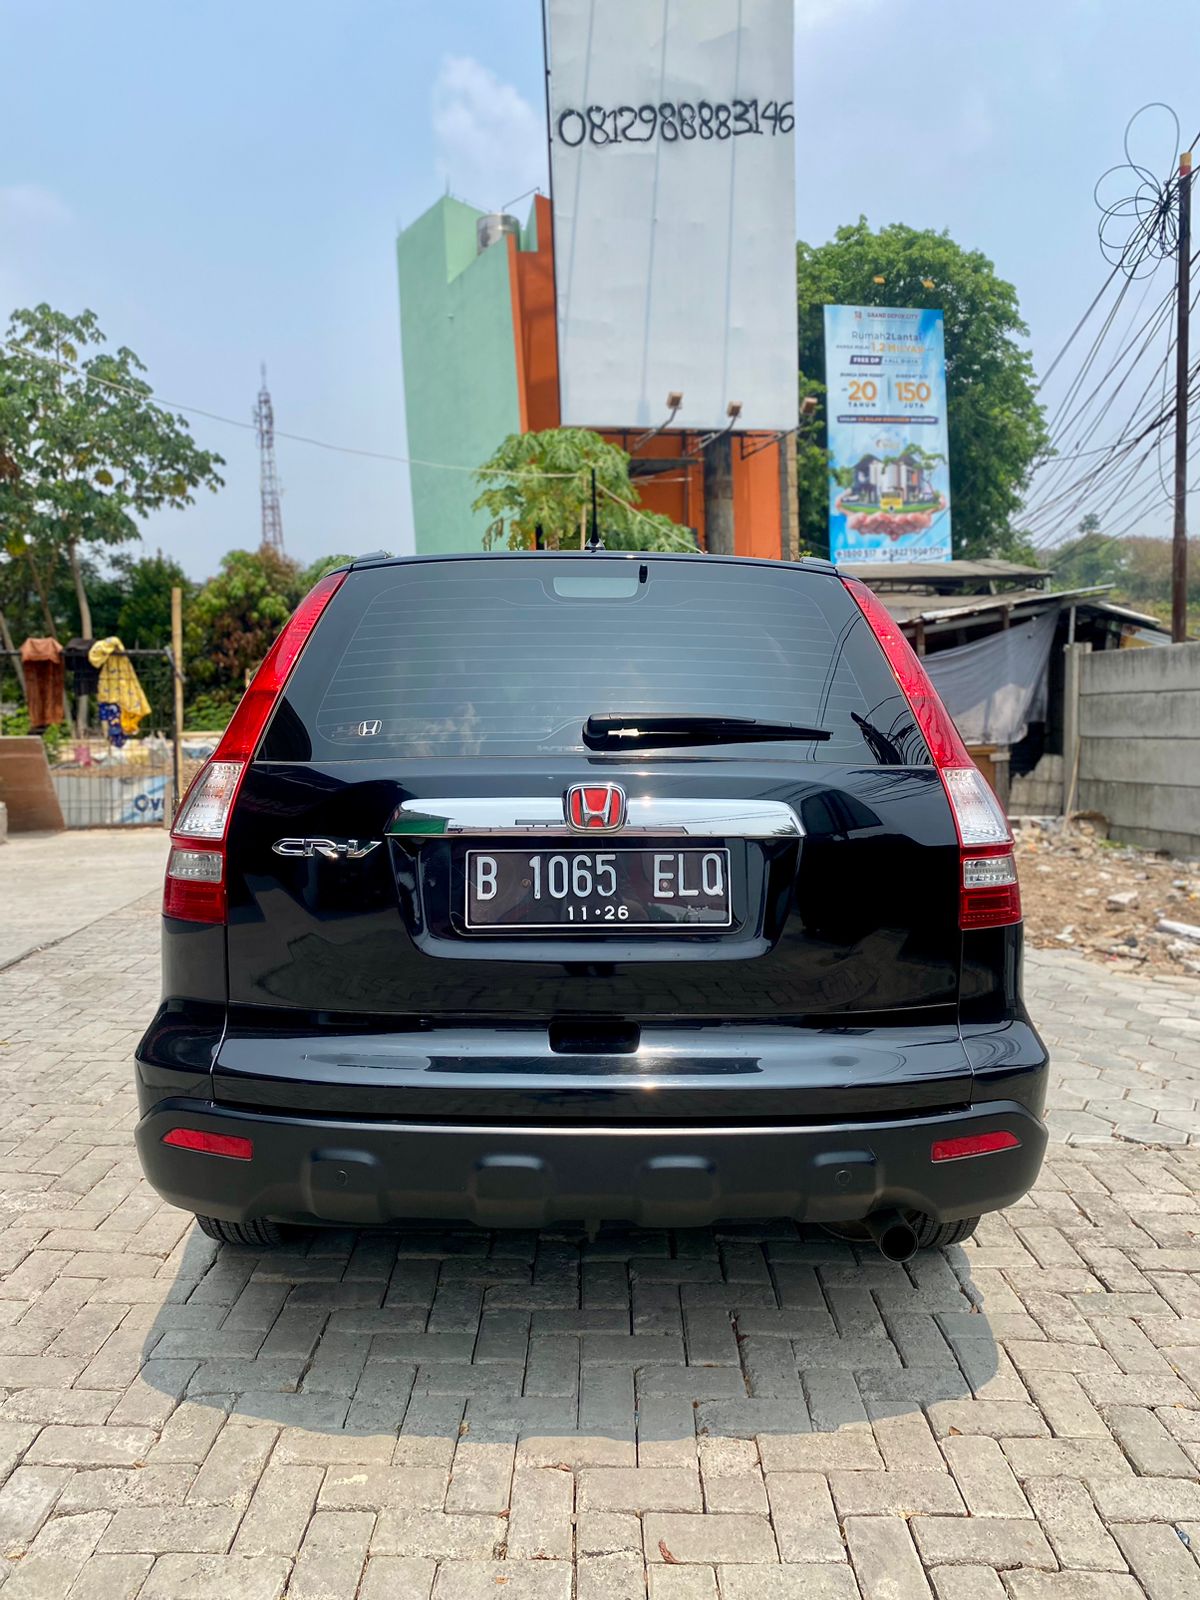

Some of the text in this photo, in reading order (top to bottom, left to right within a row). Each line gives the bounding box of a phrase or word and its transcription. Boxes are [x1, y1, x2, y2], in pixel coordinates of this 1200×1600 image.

[558, 99, 795, 147] 0812988883146
[848, 380, 878, 401] 20
[894, 381, 932, 402] 150
[272, 838, 382, 859] CR-V
[476, 853, 724, 901] B 1065 ELQ
